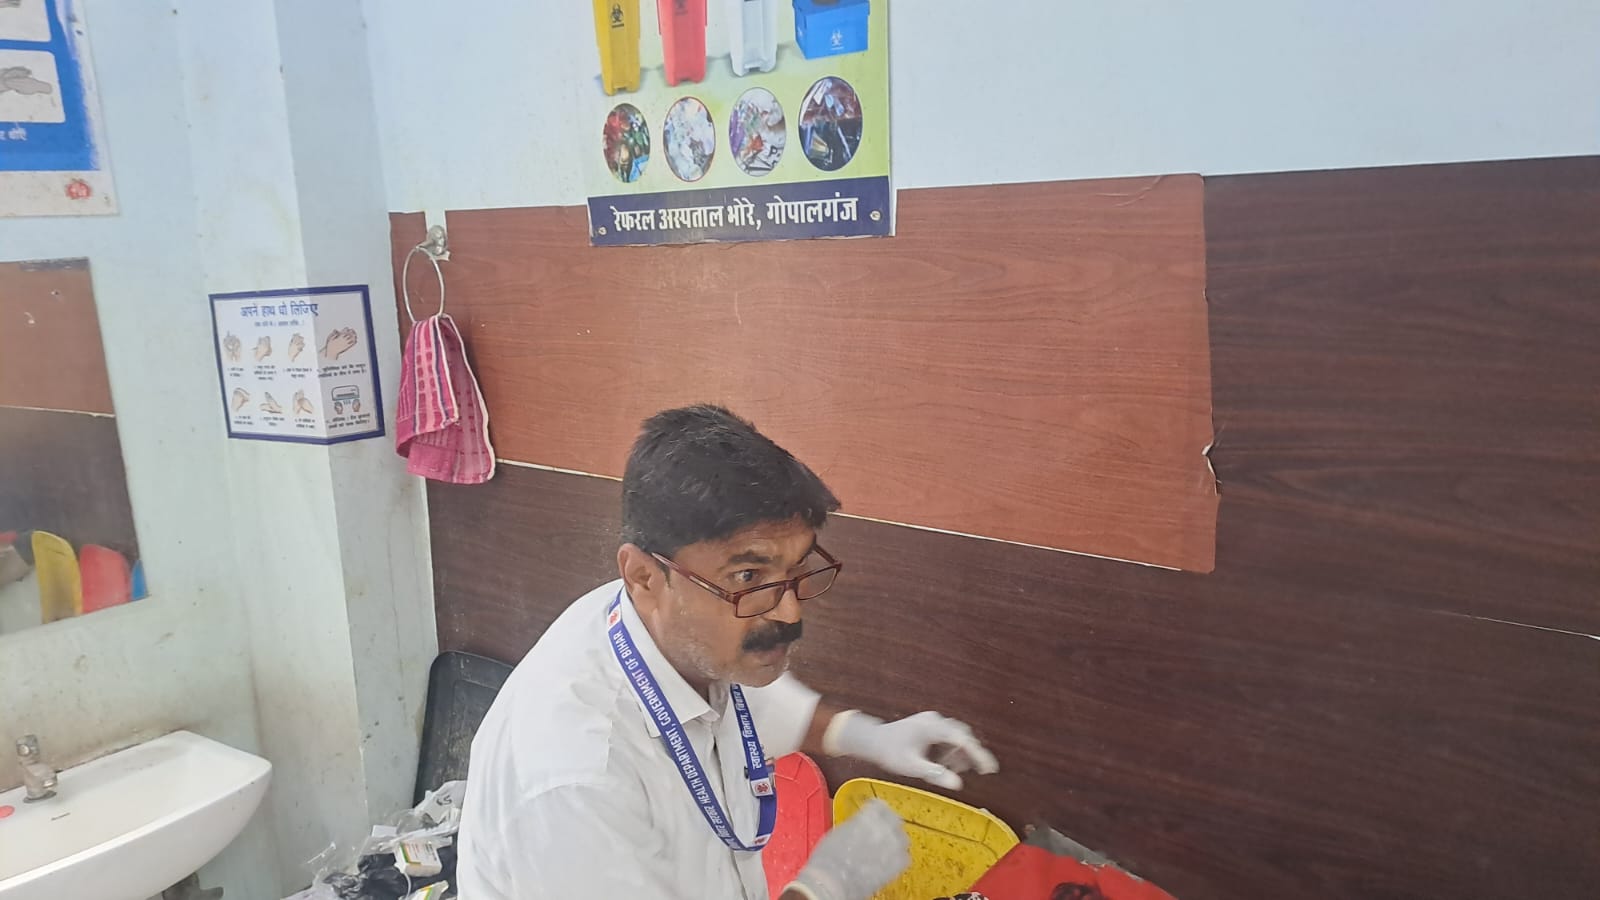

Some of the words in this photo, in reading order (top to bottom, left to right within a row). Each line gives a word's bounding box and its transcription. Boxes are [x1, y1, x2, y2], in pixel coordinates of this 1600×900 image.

[610, 206, 655, 232] रेफरल
[658, 205, 724, 230] अस्पताल
[727, 198, 762, 230] भोरे,
[766, 192, 858, 225] गोपालगंज
[240, 303, 257, 317] अपने
[261, 305, 275, 318] हाथ
[612, 629, 632, 658] BIHAR
[624, 656, 639, 670] OF
[631, 668, 672, 726] GOVERNMENT
[664, 722, 697, 780] DEPARTMENT,
[746, 740, 762, 769] स्वास्थ्य
[689, 777, 709, 804] HEALTH
